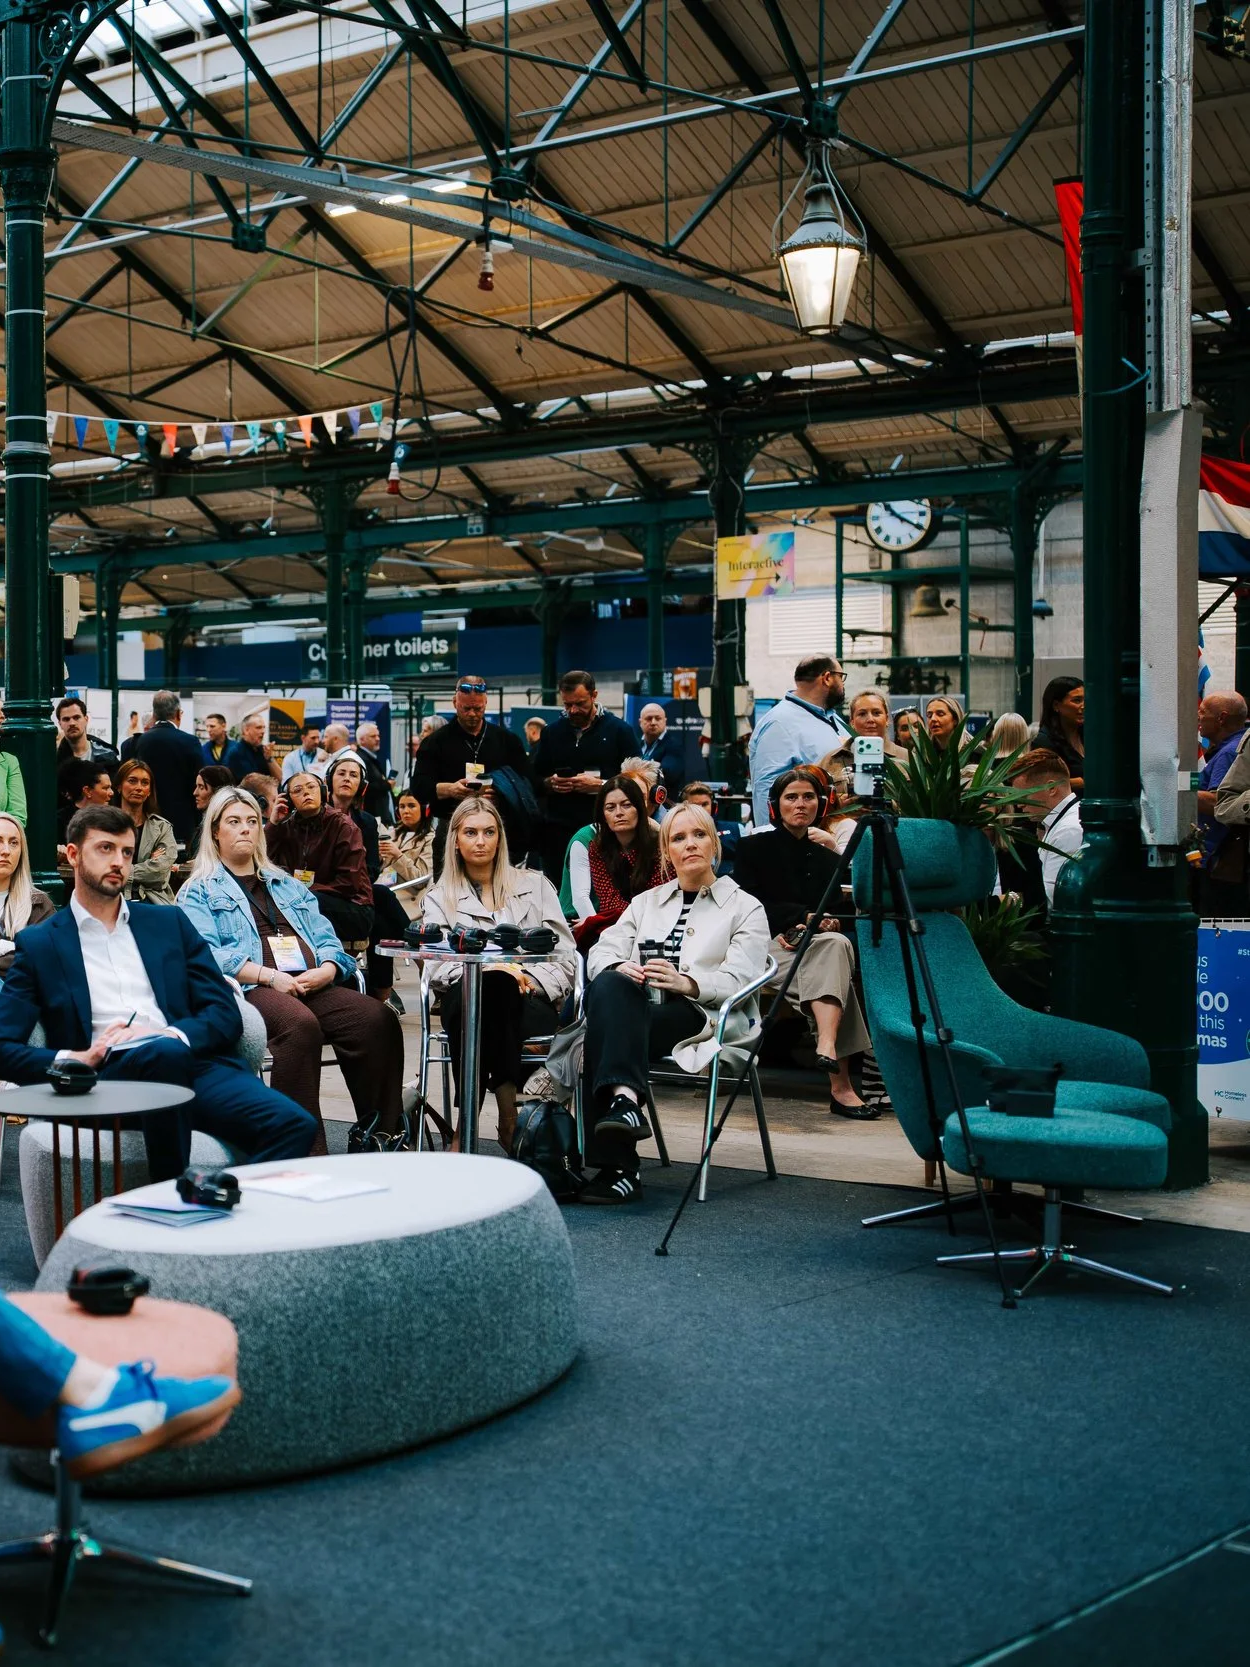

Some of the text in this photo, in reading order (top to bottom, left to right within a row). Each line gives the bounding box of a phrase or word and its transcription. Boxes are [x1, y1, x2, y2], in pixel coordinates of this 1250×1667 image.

[729, 557, 784, 571] Interactive
[395, 636, 449, 656] toilets
[1197, 991, 1229, 1012] 00
[1199, 1014, 1225, 1030] this
